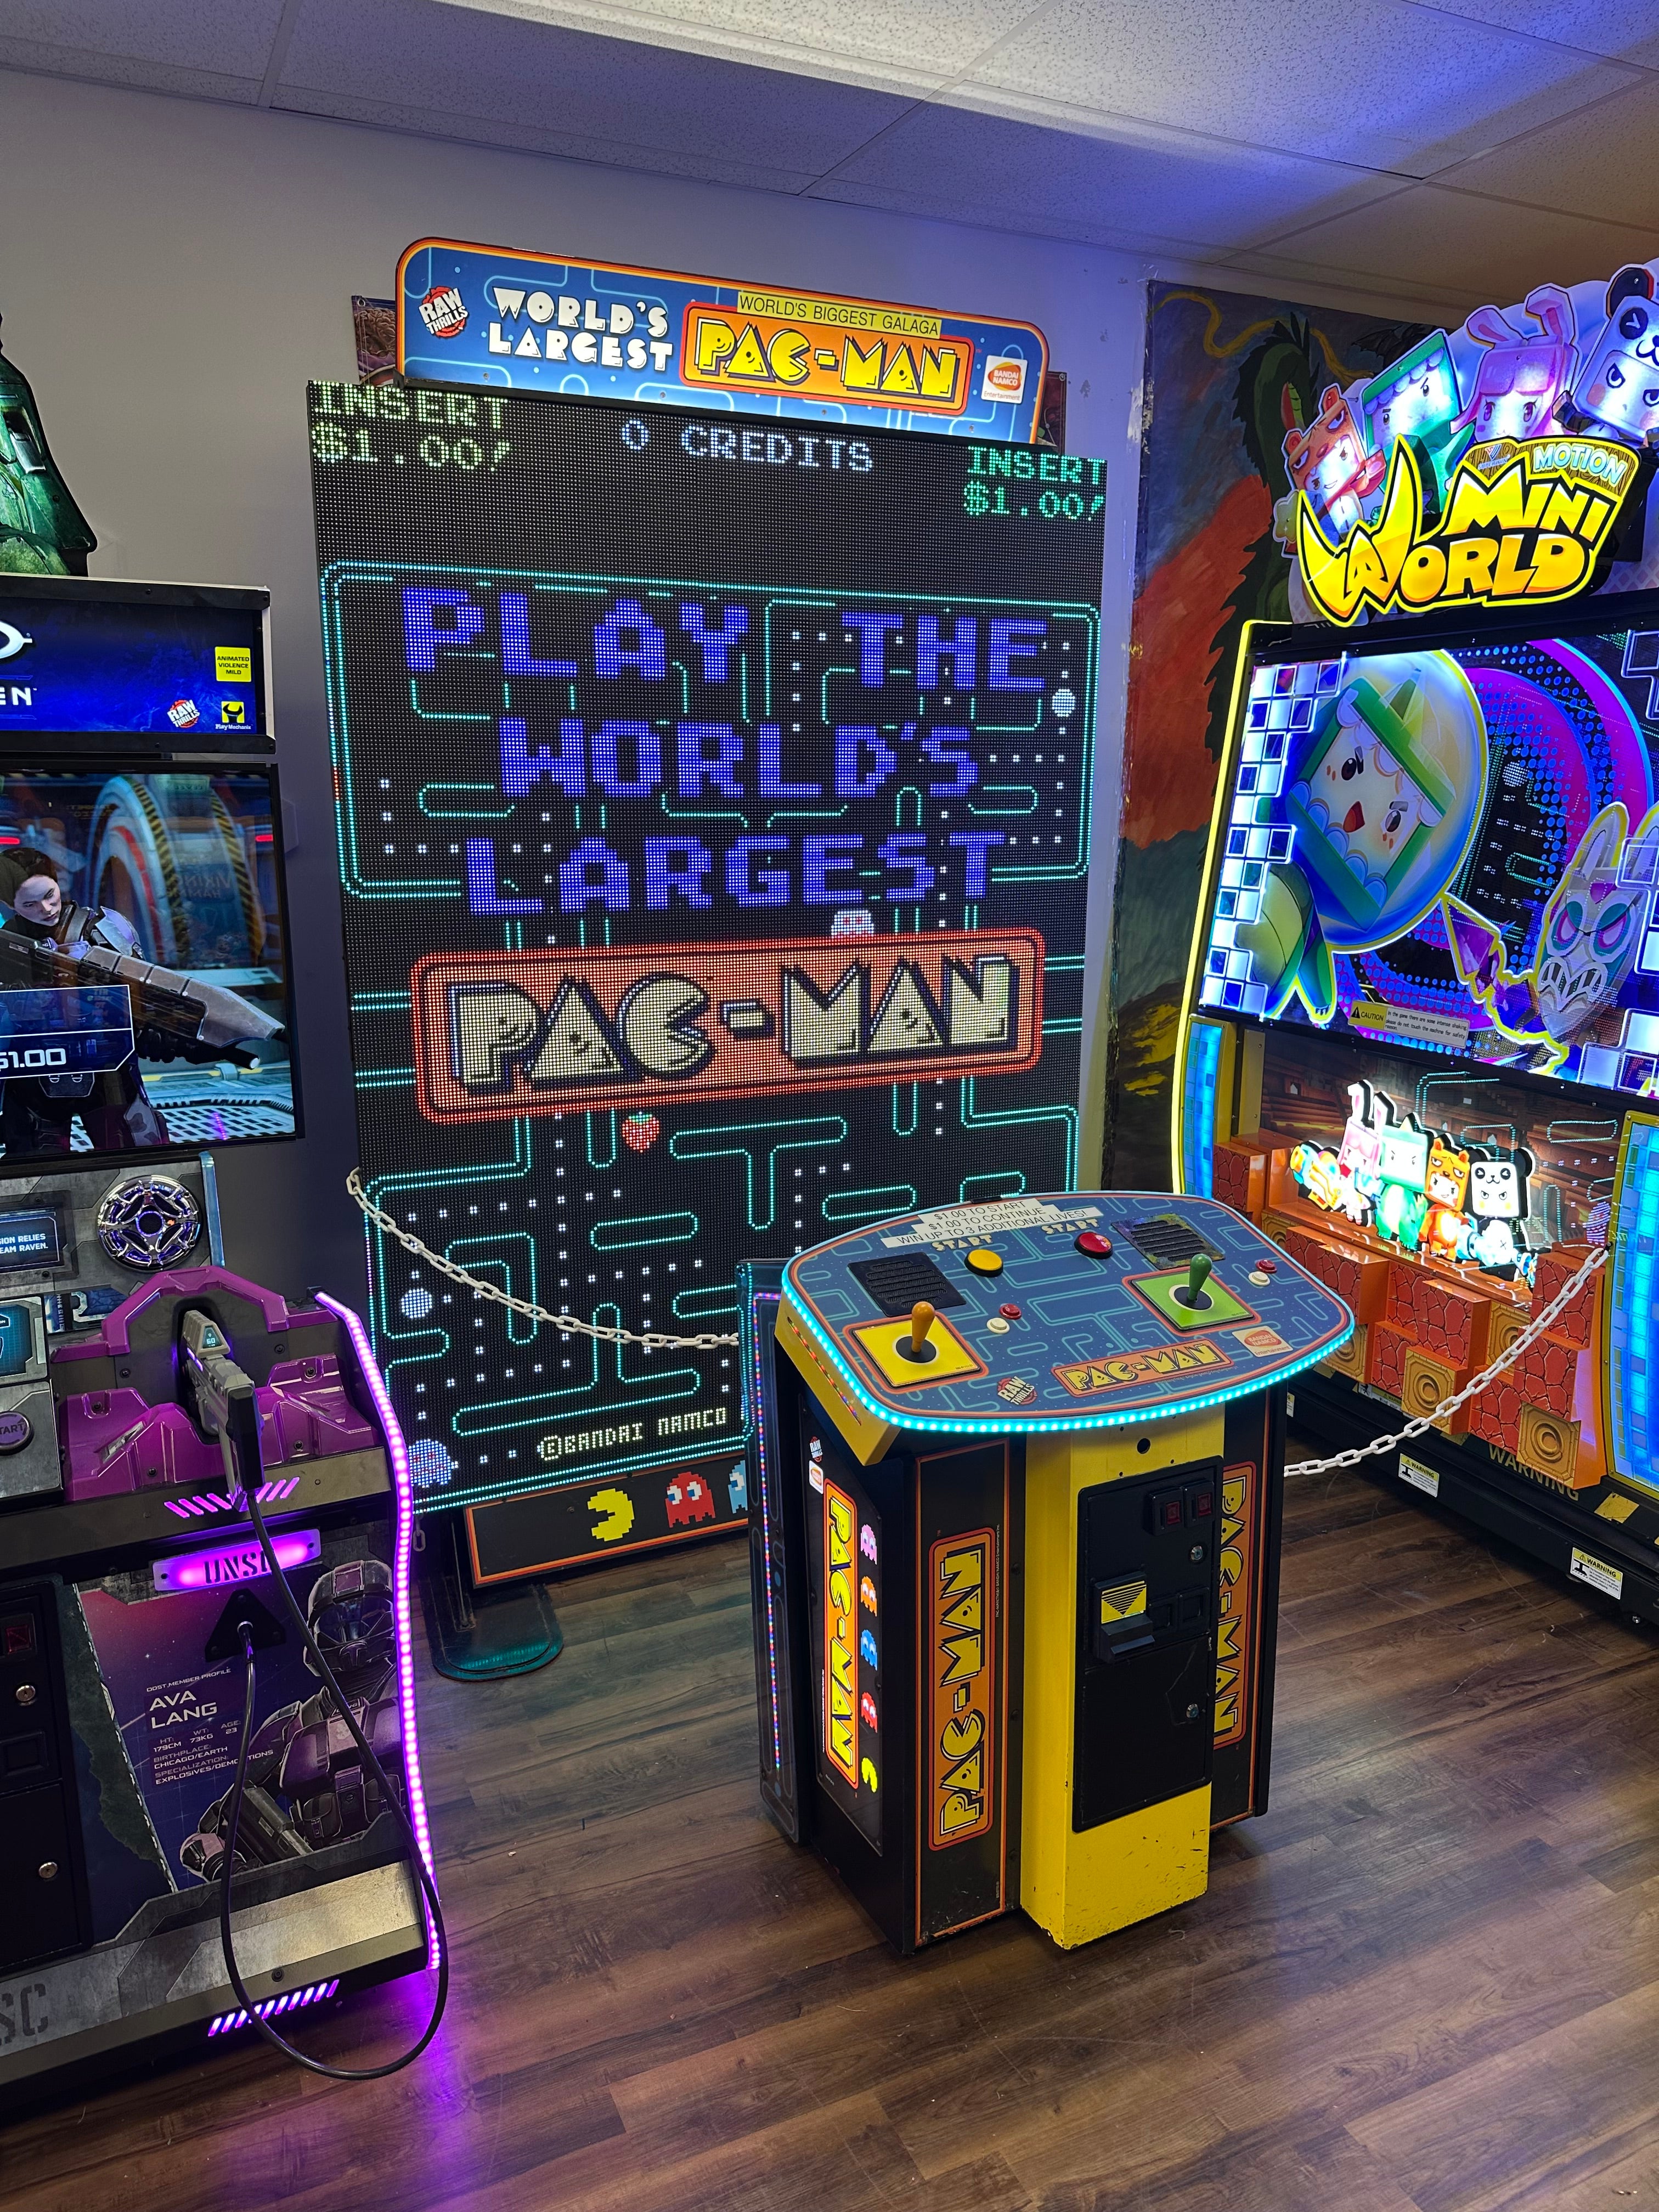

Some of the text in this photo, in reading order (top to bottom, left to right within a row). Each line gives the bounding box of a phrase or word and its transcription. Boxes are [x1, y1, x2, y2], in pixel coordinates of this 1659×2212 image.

[419, 288, 464, 323] RAW
[492, 286, 668, 337] WORLD'S
[739, 295, 939, 336] WORLD'S BIGGEST GALAGA
[426, 306, 468, 334] THRILLS
[489, 321, 673, 371] LARGEST
[696, 317, 961, 402] PAC-MAN
[992, 376, 1018, 386] NAMCO
[994, 369, 1019, 379] BANDAI
[313, 380, 508, 428] INSERT
[984, 390, 1020, 401] Entertainment
[620, 419, 874, 472] 0 CREDITS
[967, 445, 1106, 486] INSERT
[1534, 444, 1626, 485] MOTION
[1441, 463, 1611, 542] MINI
[1301, 440, 1585, 618] WORLD
[402, 586, 1047, 690] PLAY THE
[167, 699, 196, 722] RAW
[173, 709, 200, 728] THRILLS
[499, 716, 979, 799] WORLD'S
[466, 831, 1007, 916] LARGEST
[447, 953, 1019, 1096] PAC-MAN
[1361, 1011, 1384, 1022] CAUTION
[1452, 1031, 1465, 1040] safety
[963, 1217, 980, 1227] TO
[982, 1207, 1046, 1223] CONTINUE
[969, 1206, 985, 1216] TO
[986, 1201, 1026, 1214] START
[896, 1209, 1088, 1245] WIN UP TO 3 ADDITIONAL LIVES!
[1042, 1218, 1099, 1234] START
[0, 1233, 46, 1245] ION RELIES
[19, 1242, 49, 1252] RAVEN.
[932, 1233, 993, 1251] START
[1248, 1334, 1273, 1342] BANDAI
[1254, 1345, 1291, 1356] Entertainment
[1061, 1342, 1226, 1391] PAC-MAN
[997, 1375, 1026, 1401] RAW
[1011, 1383, 1035, 1405] THRILLS
[658, 1407, 726, 1436] NAMCO
[1411, 1462, 1435, 1479] WARNING
[1587, 1557, 1616, 1578] WARNING
[828, 1494, 854, 1770] PAC-MAN
[168, 1676, 200, 1688] MEMBER
[201, 1668, 232, 1679] PROFILE
[939, 1542, 986, 1837] PAC-MAN
[149, 1690, 196, 1711] AVA
[151, 1702, 217, 1729] LANG
[154, 1741, 182, 1752] 179CM
[190, 1733, 213, 1743] 73KG
[154, 1744, 211, 1763] BIRTHPLACE:
[154, 1746, 228, 1769] CHICAGO/EARTH
[155, 1755, 228, 1778] SPECIALIZATION:
